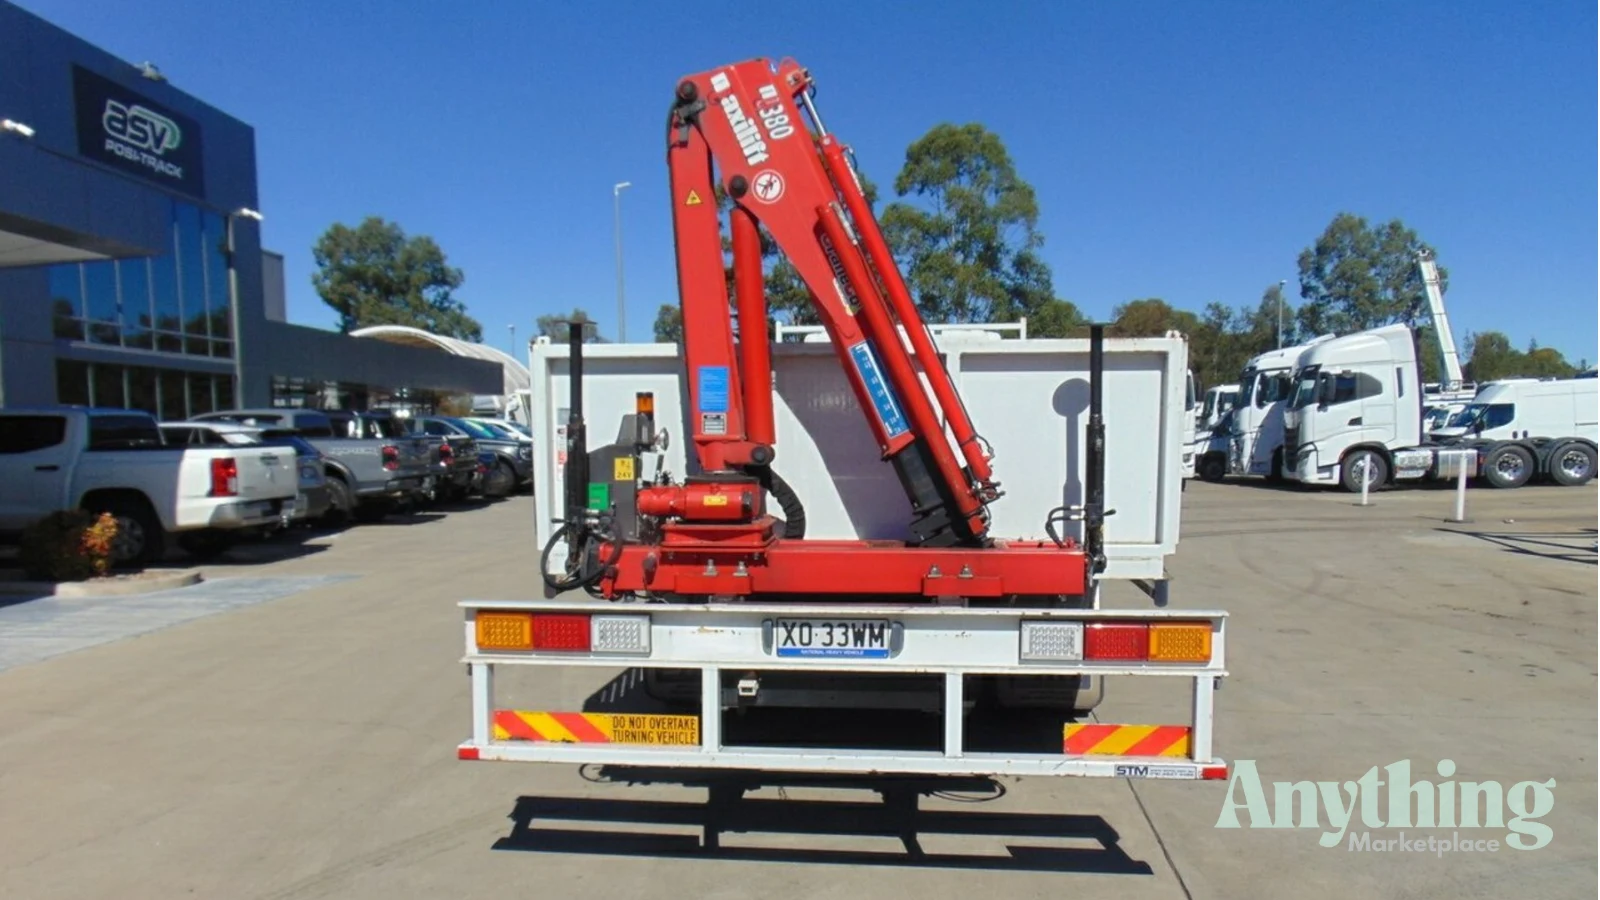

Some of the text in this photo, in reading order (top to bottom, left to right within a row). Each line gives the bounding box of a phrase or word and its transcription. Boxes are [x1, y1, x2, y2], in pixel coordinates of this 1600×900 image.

[104, 138, 183, 179] POSI-TRACK
[612, 715, 697, 731] DO NOT OVERTAKE
[612, 729, 696, 745] TURNING VEHICLE
[1116, 766, 1149, 776] STM
